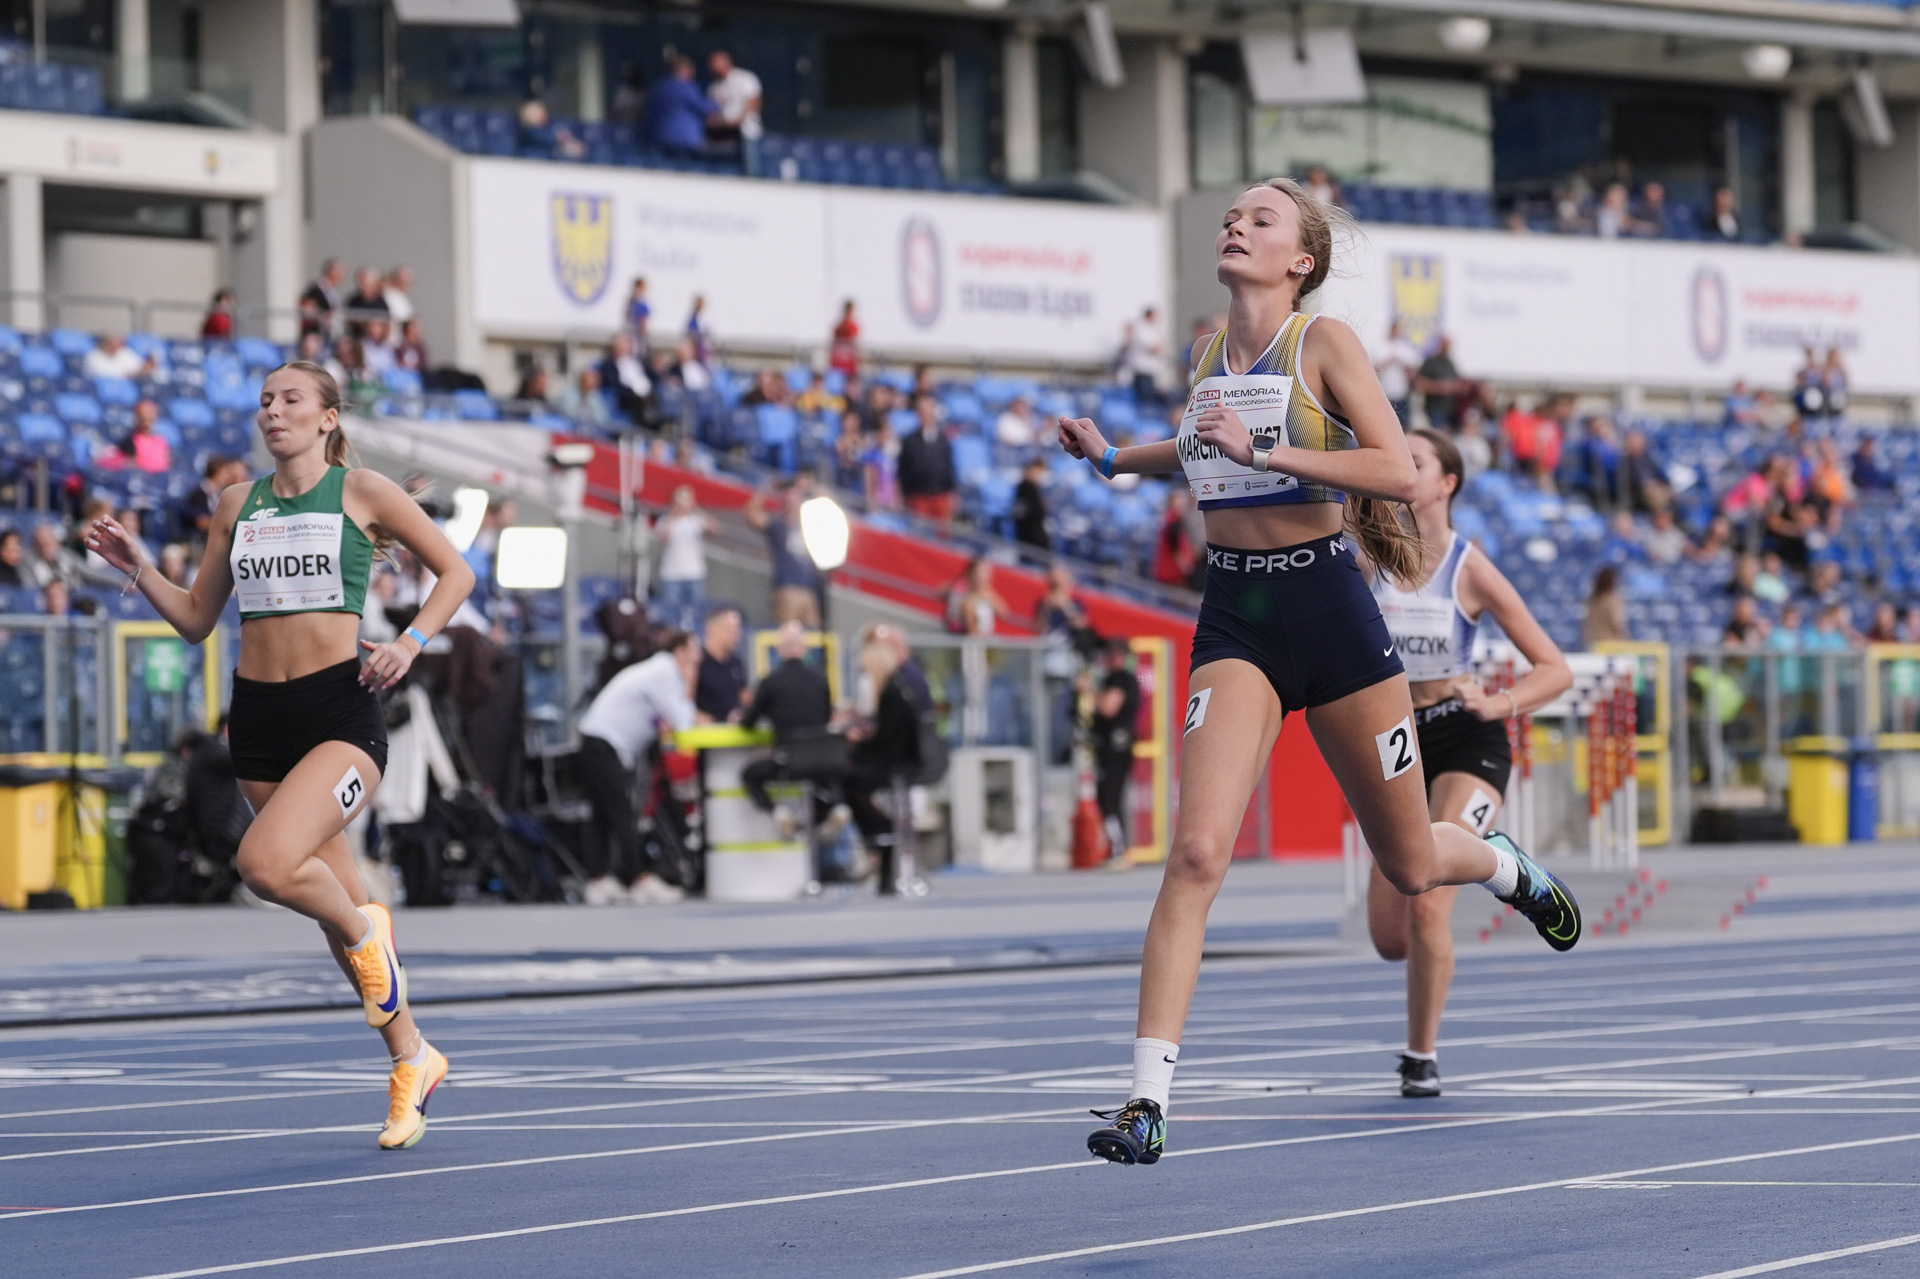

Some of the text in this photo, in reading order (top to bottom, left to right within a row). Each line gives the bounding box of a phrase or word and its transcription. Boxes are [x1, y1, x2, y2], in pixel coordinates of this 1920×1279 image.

[1195, 398, 1283, 411] JANUSZ KUSOCIŃSKIEGO
[1197, 390, 1220, 402] ORLEN
[1223, 387, 1283, 398] MEMORIAŁ
[237, 554, 333, 580] ŚWIDER
[1245, 549, 1316, 573] PRO
[1391, 636, 1449, 655] WCZYK
[1185, 696, 1201, 728] 2
[1389, 727, 1413, 773] 2
[341, 777, 362, 808] 5
[1472, 803, 1490, 827] 4
